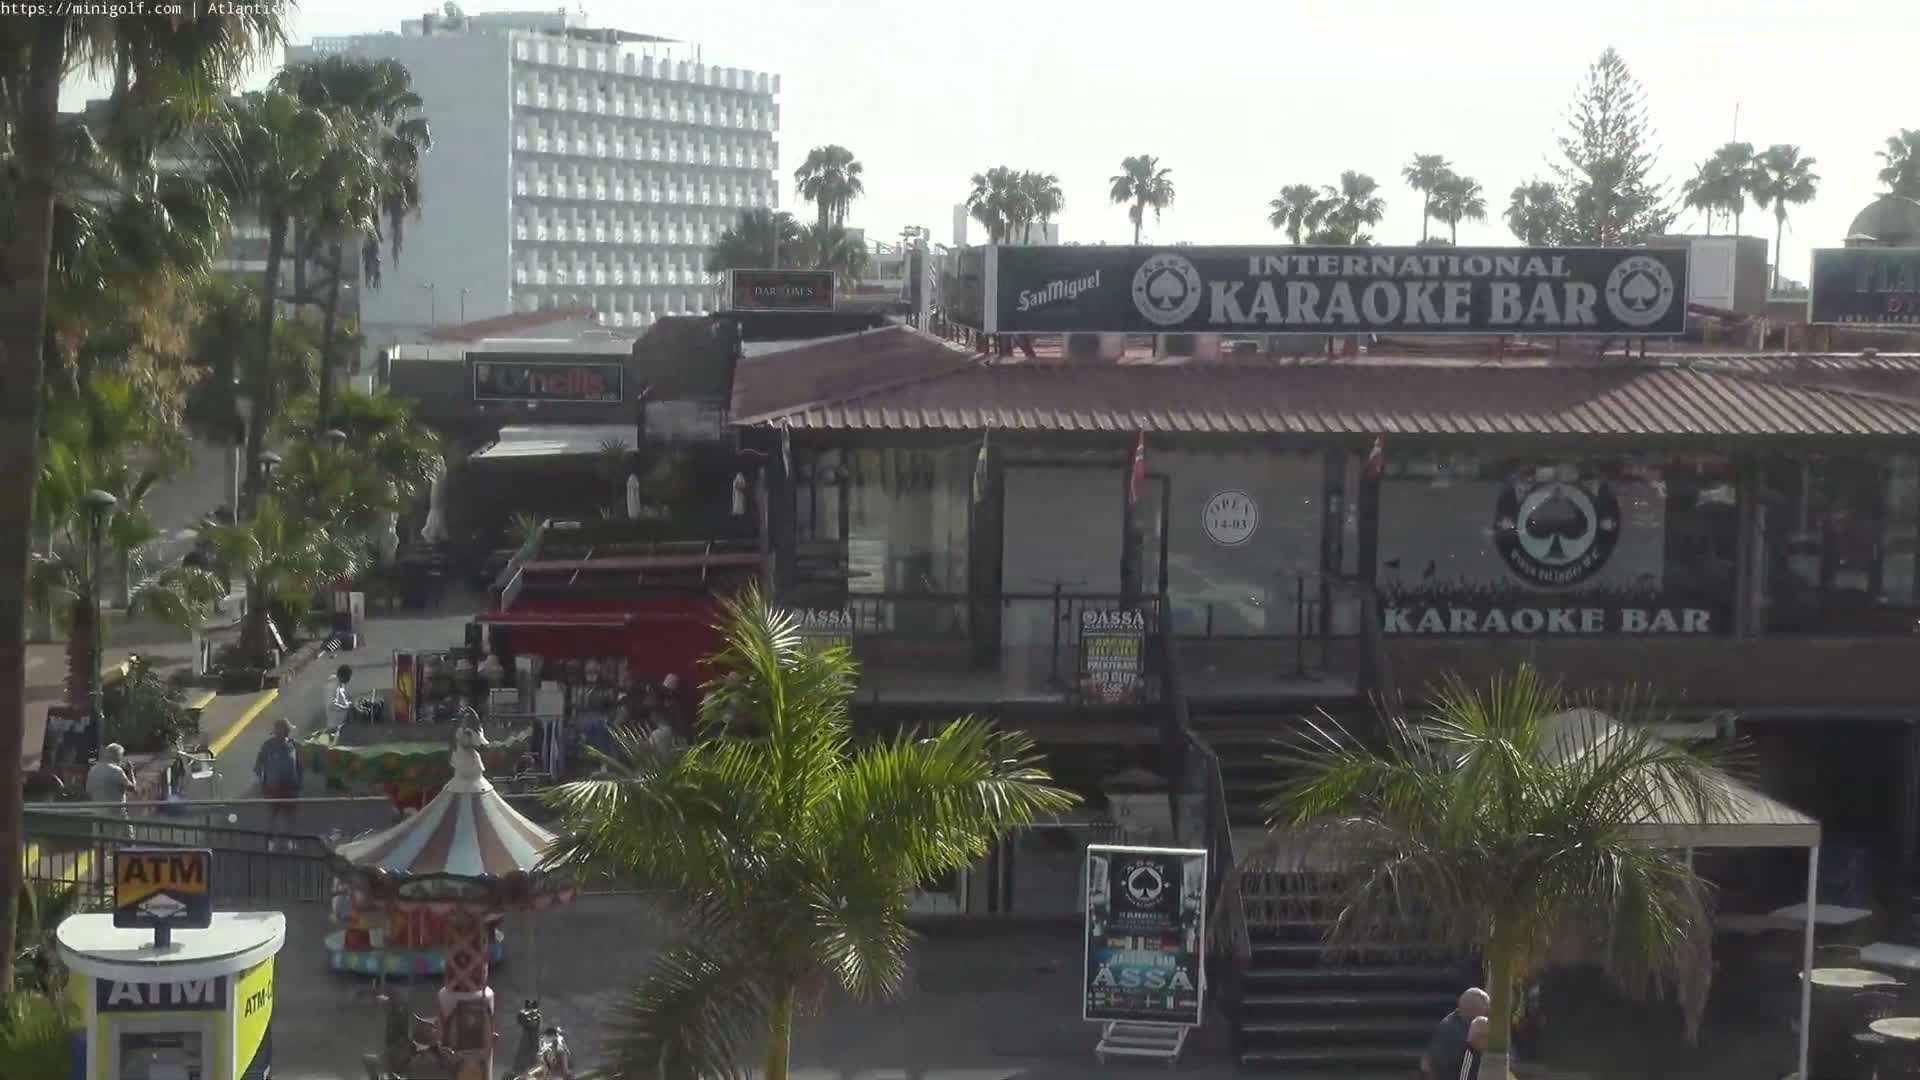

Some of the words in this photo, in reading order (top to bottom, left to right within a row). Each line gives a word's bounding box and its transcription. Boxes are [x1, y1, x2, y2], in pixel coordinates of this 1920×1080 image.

[1248, 254, 1572, 278] INTERNATIONAL
[1208, 280, 1473, 325] KARAOKE
[1489, 281, 1598, 325] BAR
[1383, 607, 1605, 634] KARAOKE
[1620, 607, 1712, 634] BAR
[124, 856, 204, 883] ATM
[1092, 962, 1195, 991] ÄSSÄ
[107, 977, 216, 1005] ATM
